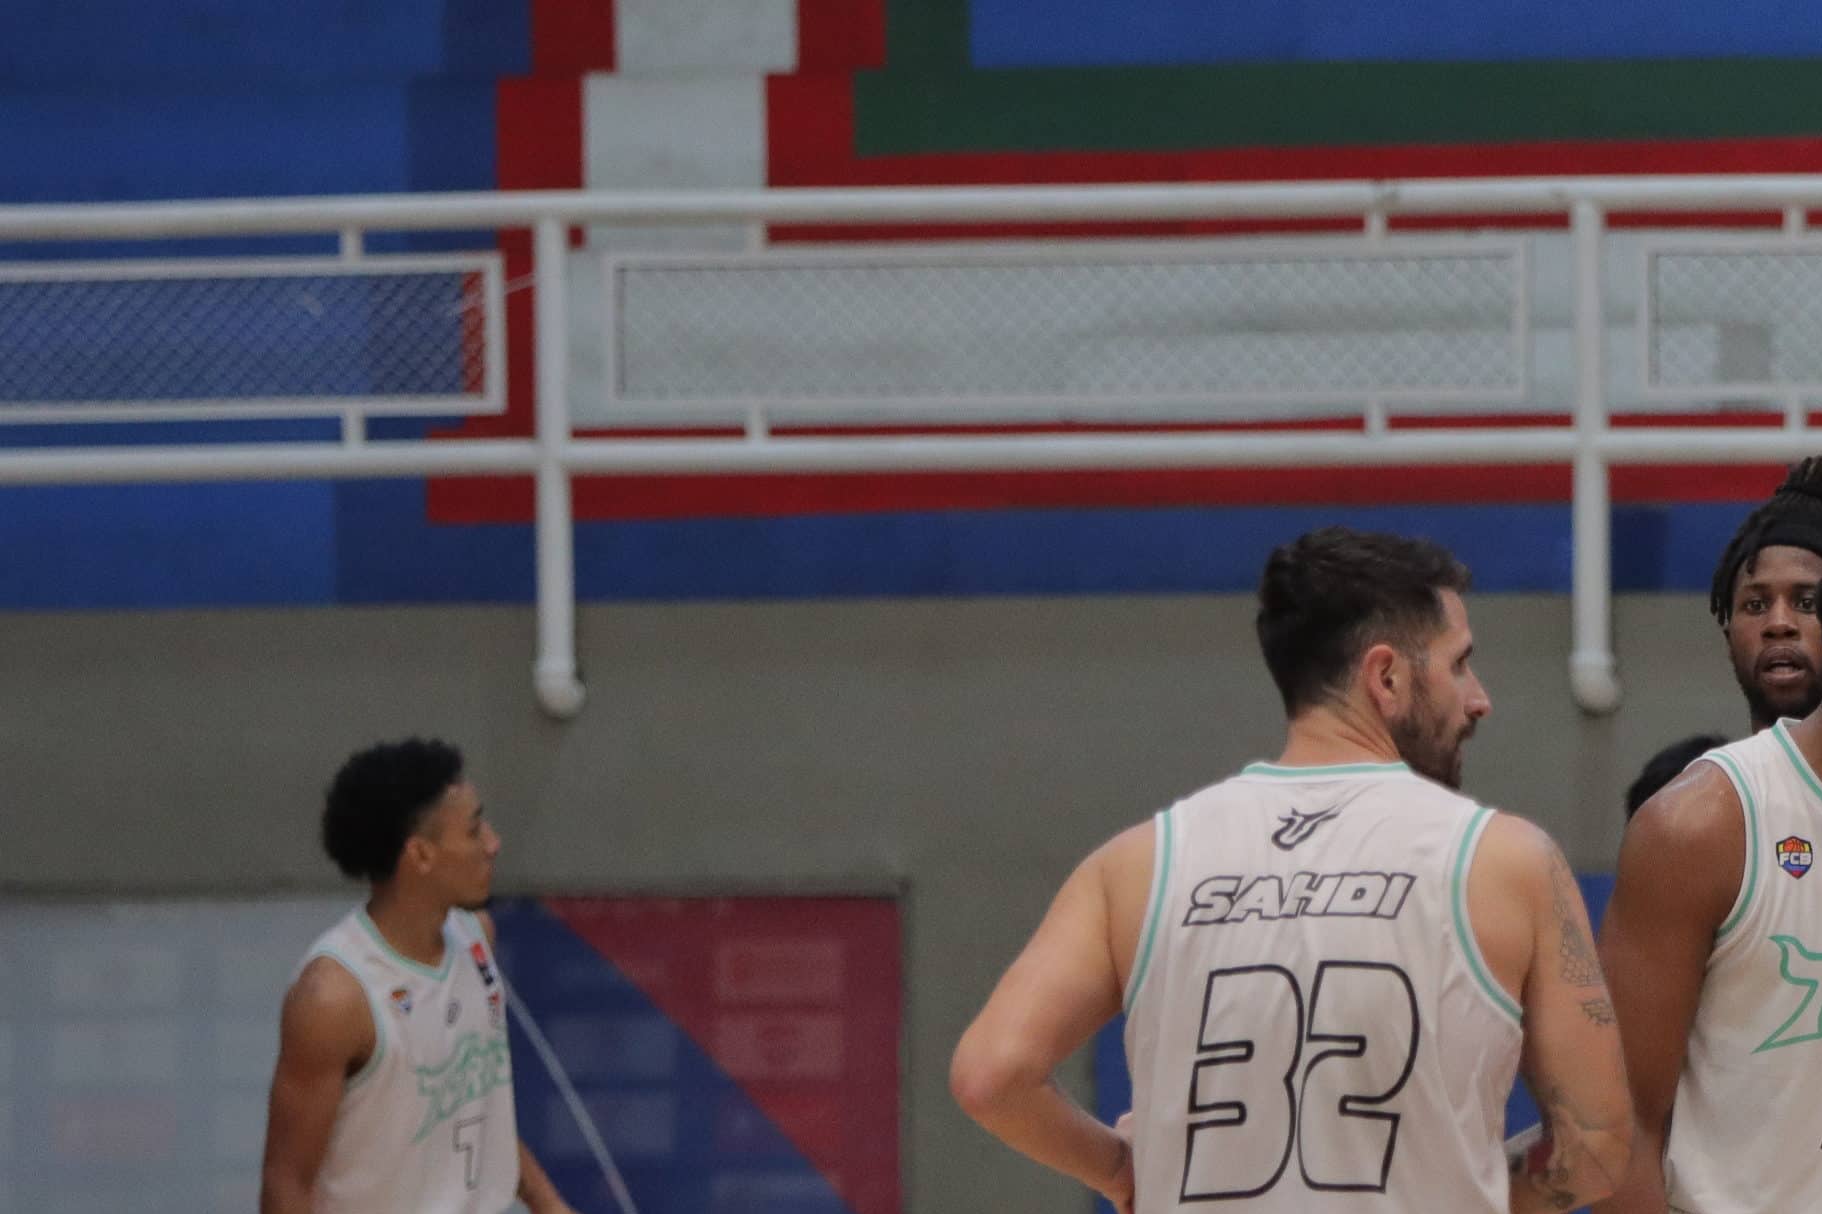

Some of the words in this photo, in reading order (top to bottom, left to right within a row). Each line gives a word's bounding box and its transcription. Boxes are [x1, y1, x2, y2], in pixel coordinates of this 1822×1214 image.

[1778, 851, 1811, 865] FCB
[1182, 871, 1417, 927] SAHDI
[1179, 960, 1420, 1204] 32
[452, 1115, 489, 1192] 7
